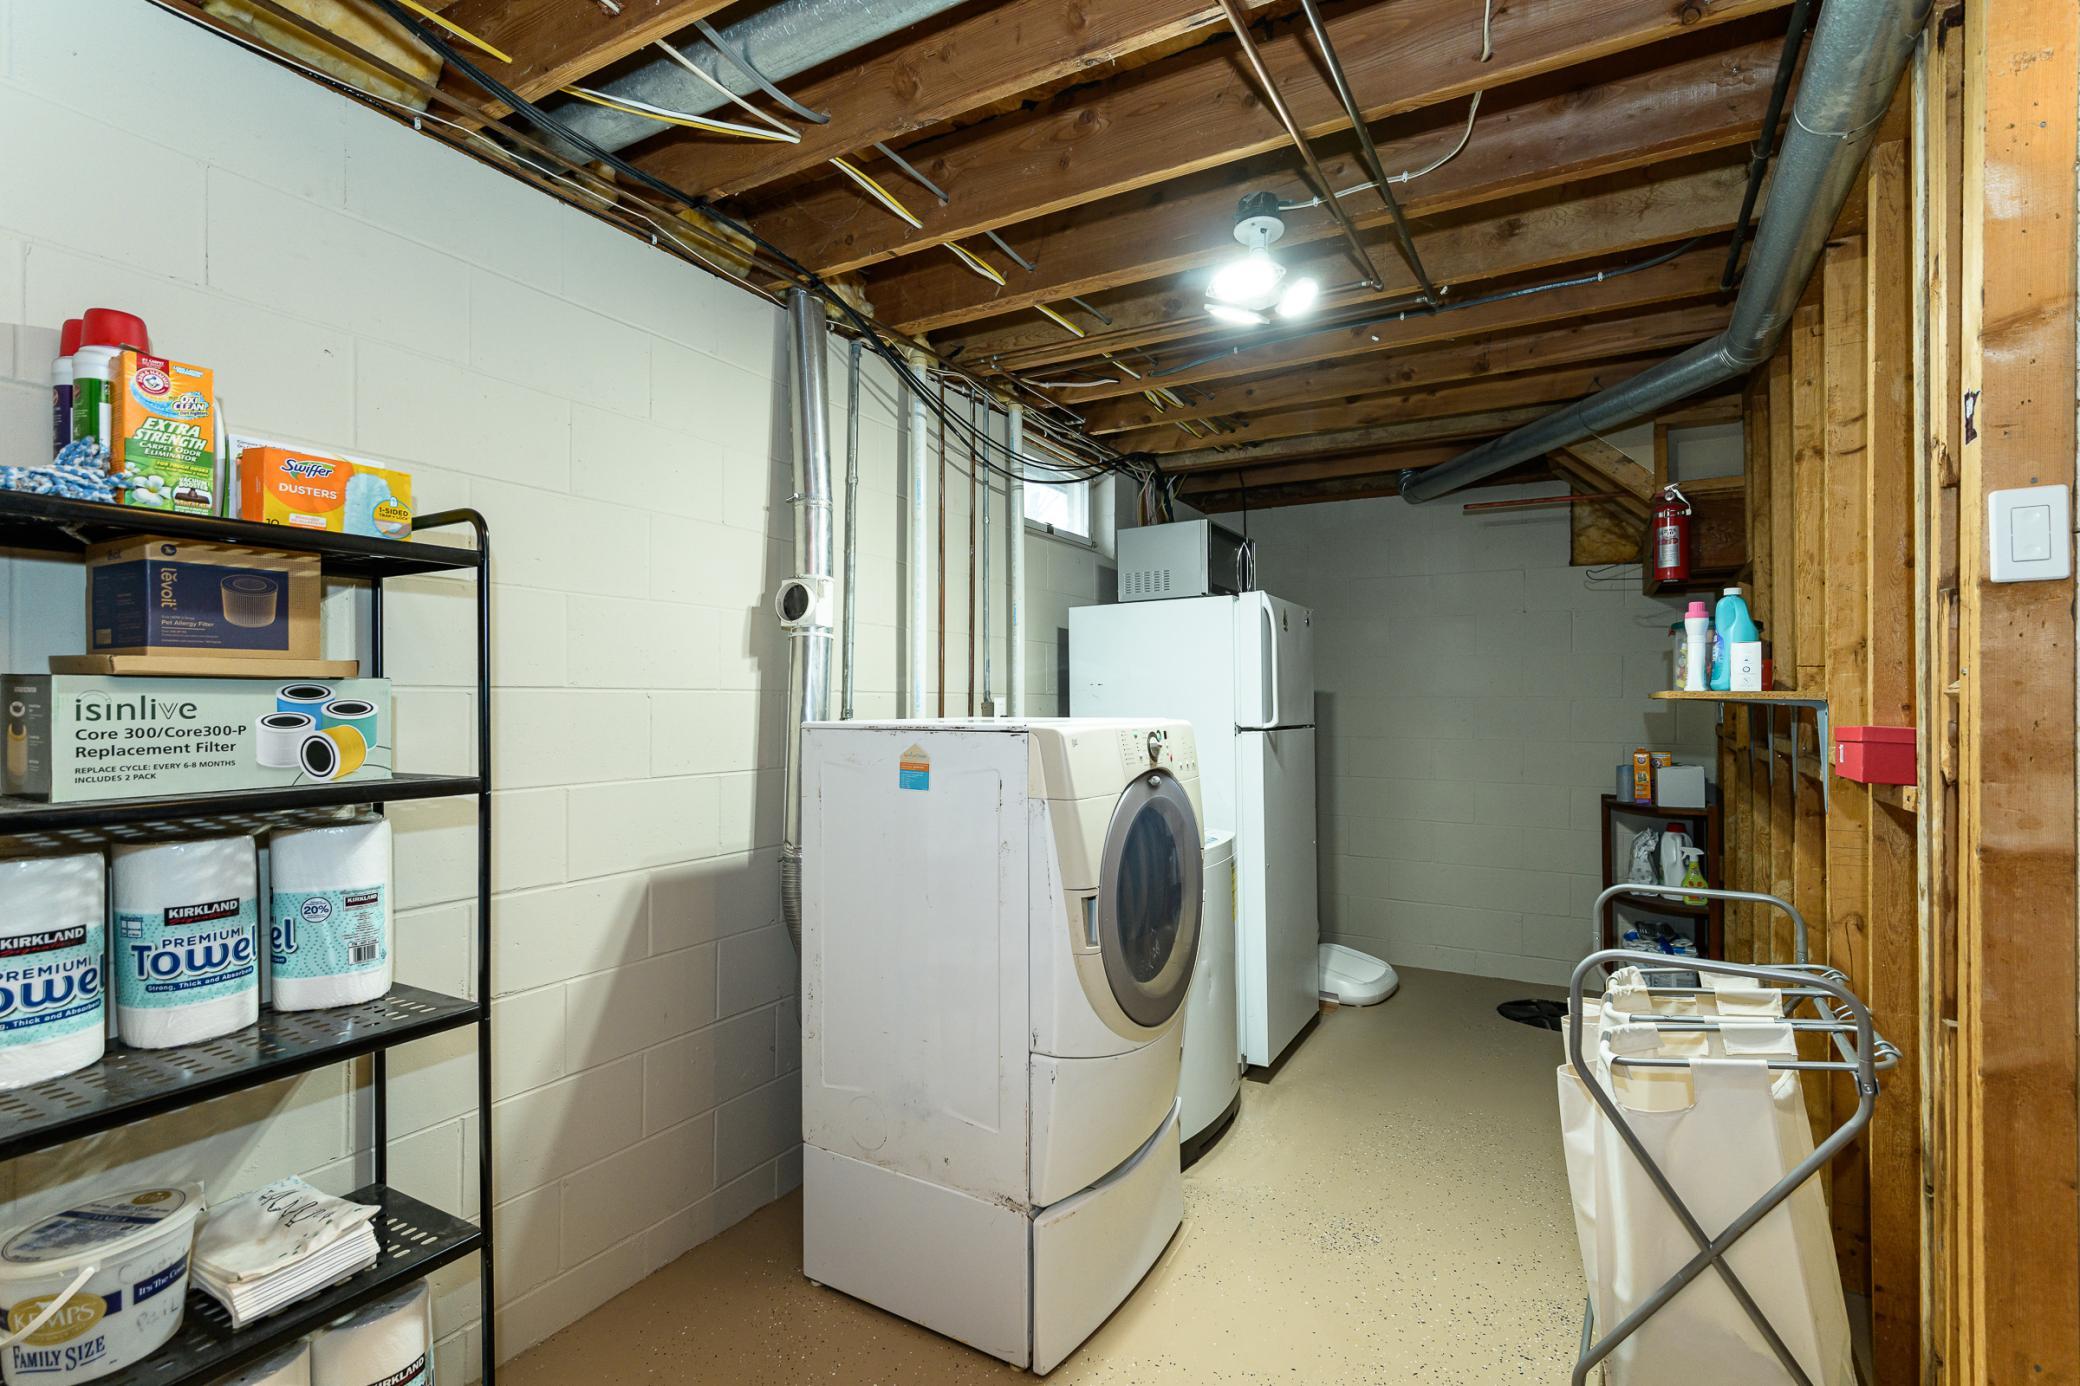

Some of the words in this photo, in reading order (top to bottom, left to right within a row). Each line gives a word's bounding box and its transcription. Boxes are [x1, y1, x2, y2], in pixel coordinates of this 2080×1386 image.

[143, 416, 201, 438] EXTRA
[134, 428, 208, 450] STRENGTH
[144, 448, 197, 462] ELIMINATOR
[281, 459, 333, 478] Swiffer
[278, 482, 337, 500] DUSTERS
[379, 507, 408, 517] 1-SIDED
[174, 619, 197, 628] Allergy
[75, 694, 198, 722] isinlive
[75, 728, 118, 741] Core
[124, 725, 247, 740] 300/Core300-P
[75, 743, 191, 760] Replacement
[196, 741, 237, 753] Filter
[74, 766, 116, 775] REPLACE
[120, 764, 151, 772] CYCLE:
[153, 762, 181, 771] EVERY
[199, 760, 236, 768] MONTHS
[74, 775, 122, 784] INCLUDES
[133, 773, 156, 781] PACK
[347, 893, 378, 903] KIRKLAND
[169, 901, 238, 919] KIRKLAND
[304, 904, 329, 915] 20%
[0, 928, 84, 951] KIRKLAND
[162, 927, 240, 949] PREMIUM
[131, 924, 257, 977] Towel
[0, 957, 87, 982] REMIUM
[179, 981, 202, 989] Thick
[13, 1016, 40, 1027] Thick
[44, 1012, 62, 1021] and
[13, 1345, 61, 1368] FAMILY
[65, 1335, 105, 1371] SIZE
[375, 1356, 424, 1386] IRKLAND
